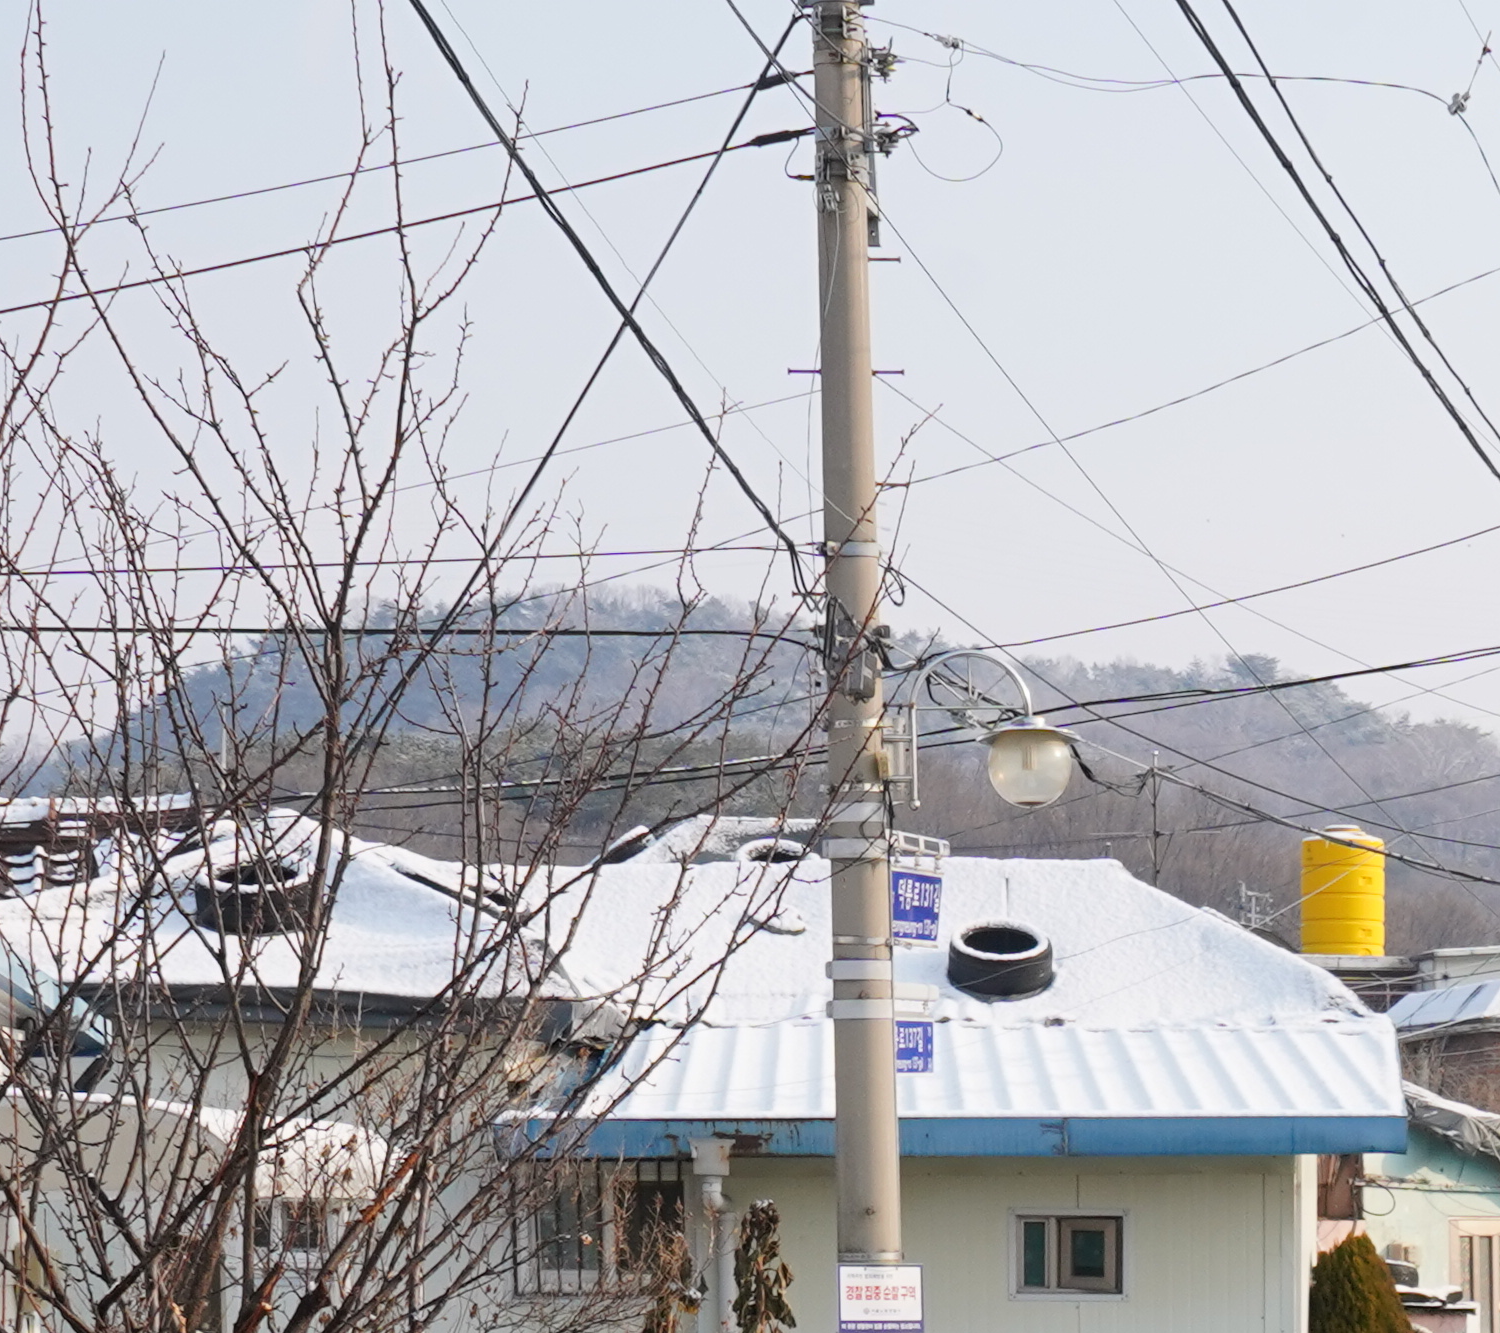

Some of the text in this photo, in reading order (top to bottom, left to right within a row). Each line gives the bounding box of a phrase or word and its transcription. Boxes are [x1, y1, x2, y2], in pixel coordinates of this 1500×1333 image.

[895, 1026, 924, 1053] 로137길
[846, 1286, 916, 1300] 경찰 집중 순찰 구역
